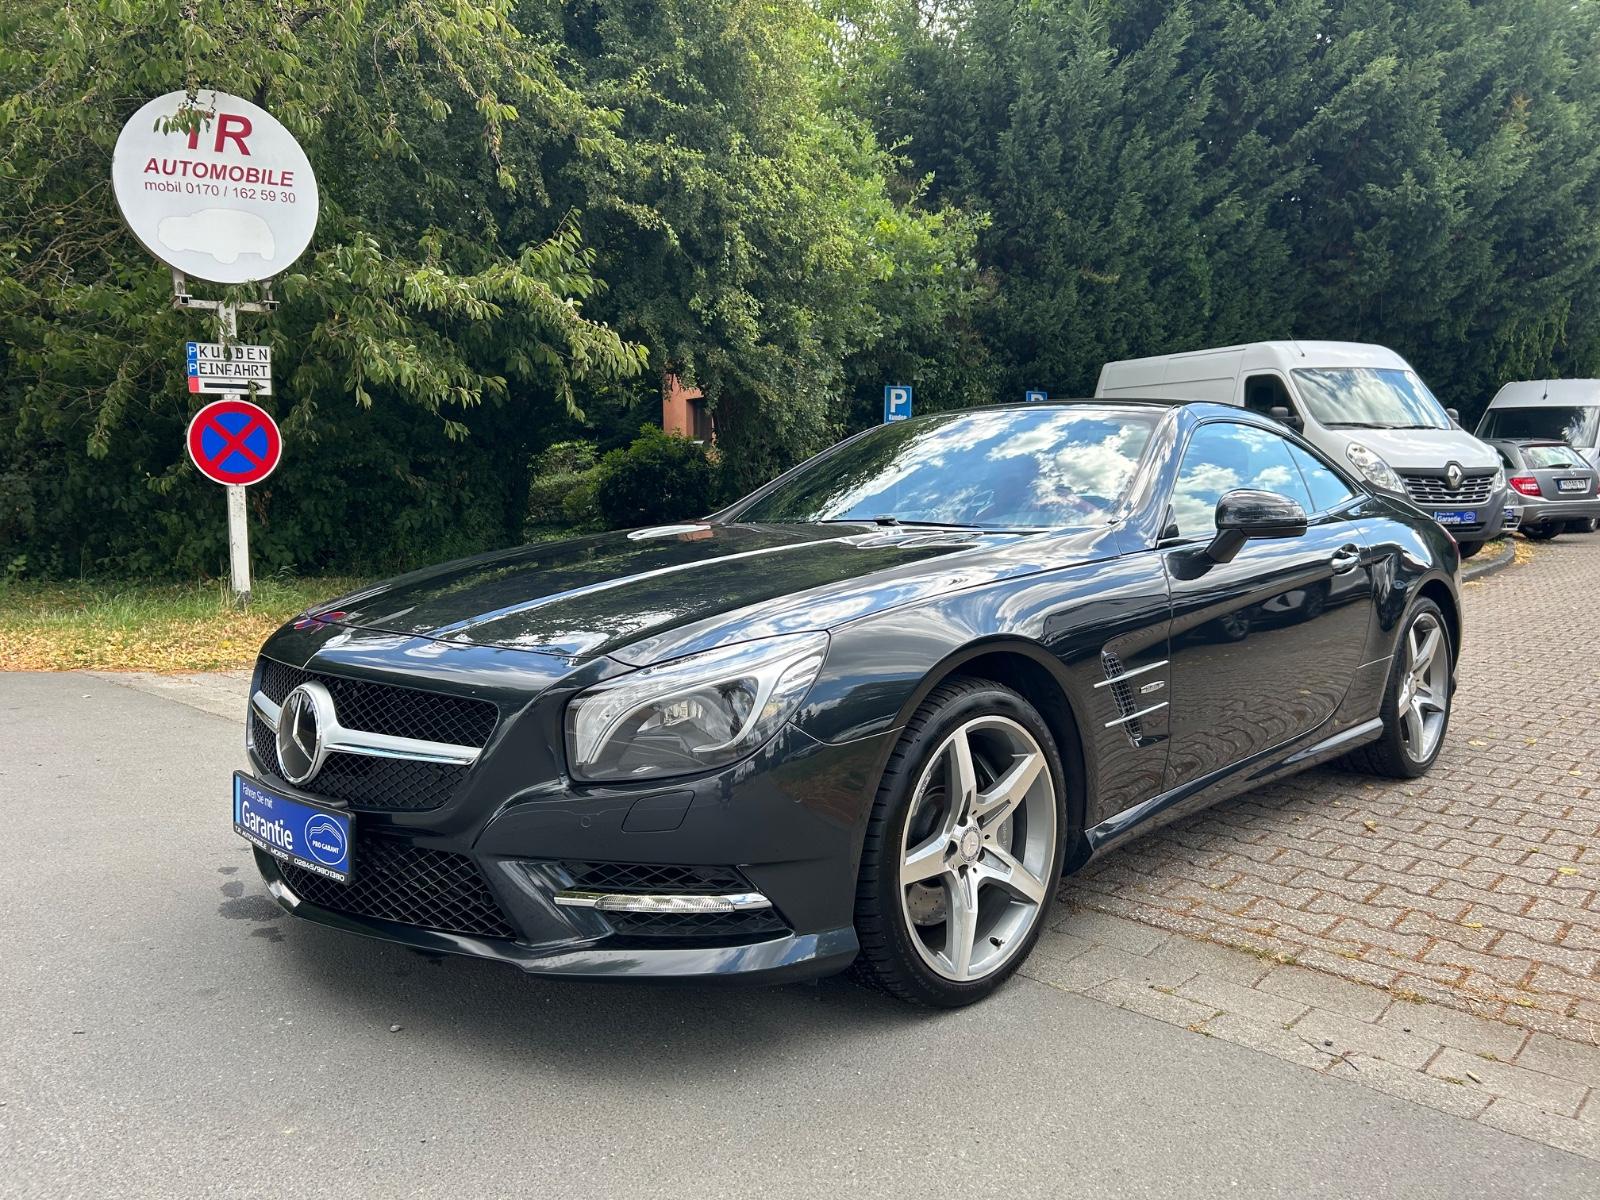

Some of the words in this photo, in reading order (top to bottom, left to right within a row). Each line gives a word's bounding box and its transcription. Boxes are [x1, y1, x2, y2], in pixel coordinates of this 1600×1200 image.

[144, 158, 294, 187] AUTOMOBILE
[144, 180, 181, 193] mobil
[186, 182, 219, 196] 0170
[224, 185, 228, 197] /
[233, 187, 256, 200] 162
[261, 190, 276, 202] 59
[280, 193, 296, 204] 30
[188, 346, 197, 356] P
[199, 345, 268, 361] KUDEN
[189, 363, 197, 373] P
[199, 362, 268, 377] EINFAHRT
[890, 388, 907, 413] P
[242, 782, 257, 800] Fahren
[256, 790, 265, 805] Sie
[264, 796, 273, 810] mit
[242, 800, 293, 850] Garantie
[241, 830, 267, 850] AUTOMOBILE
[270, 847, 289, 861] MOERS
